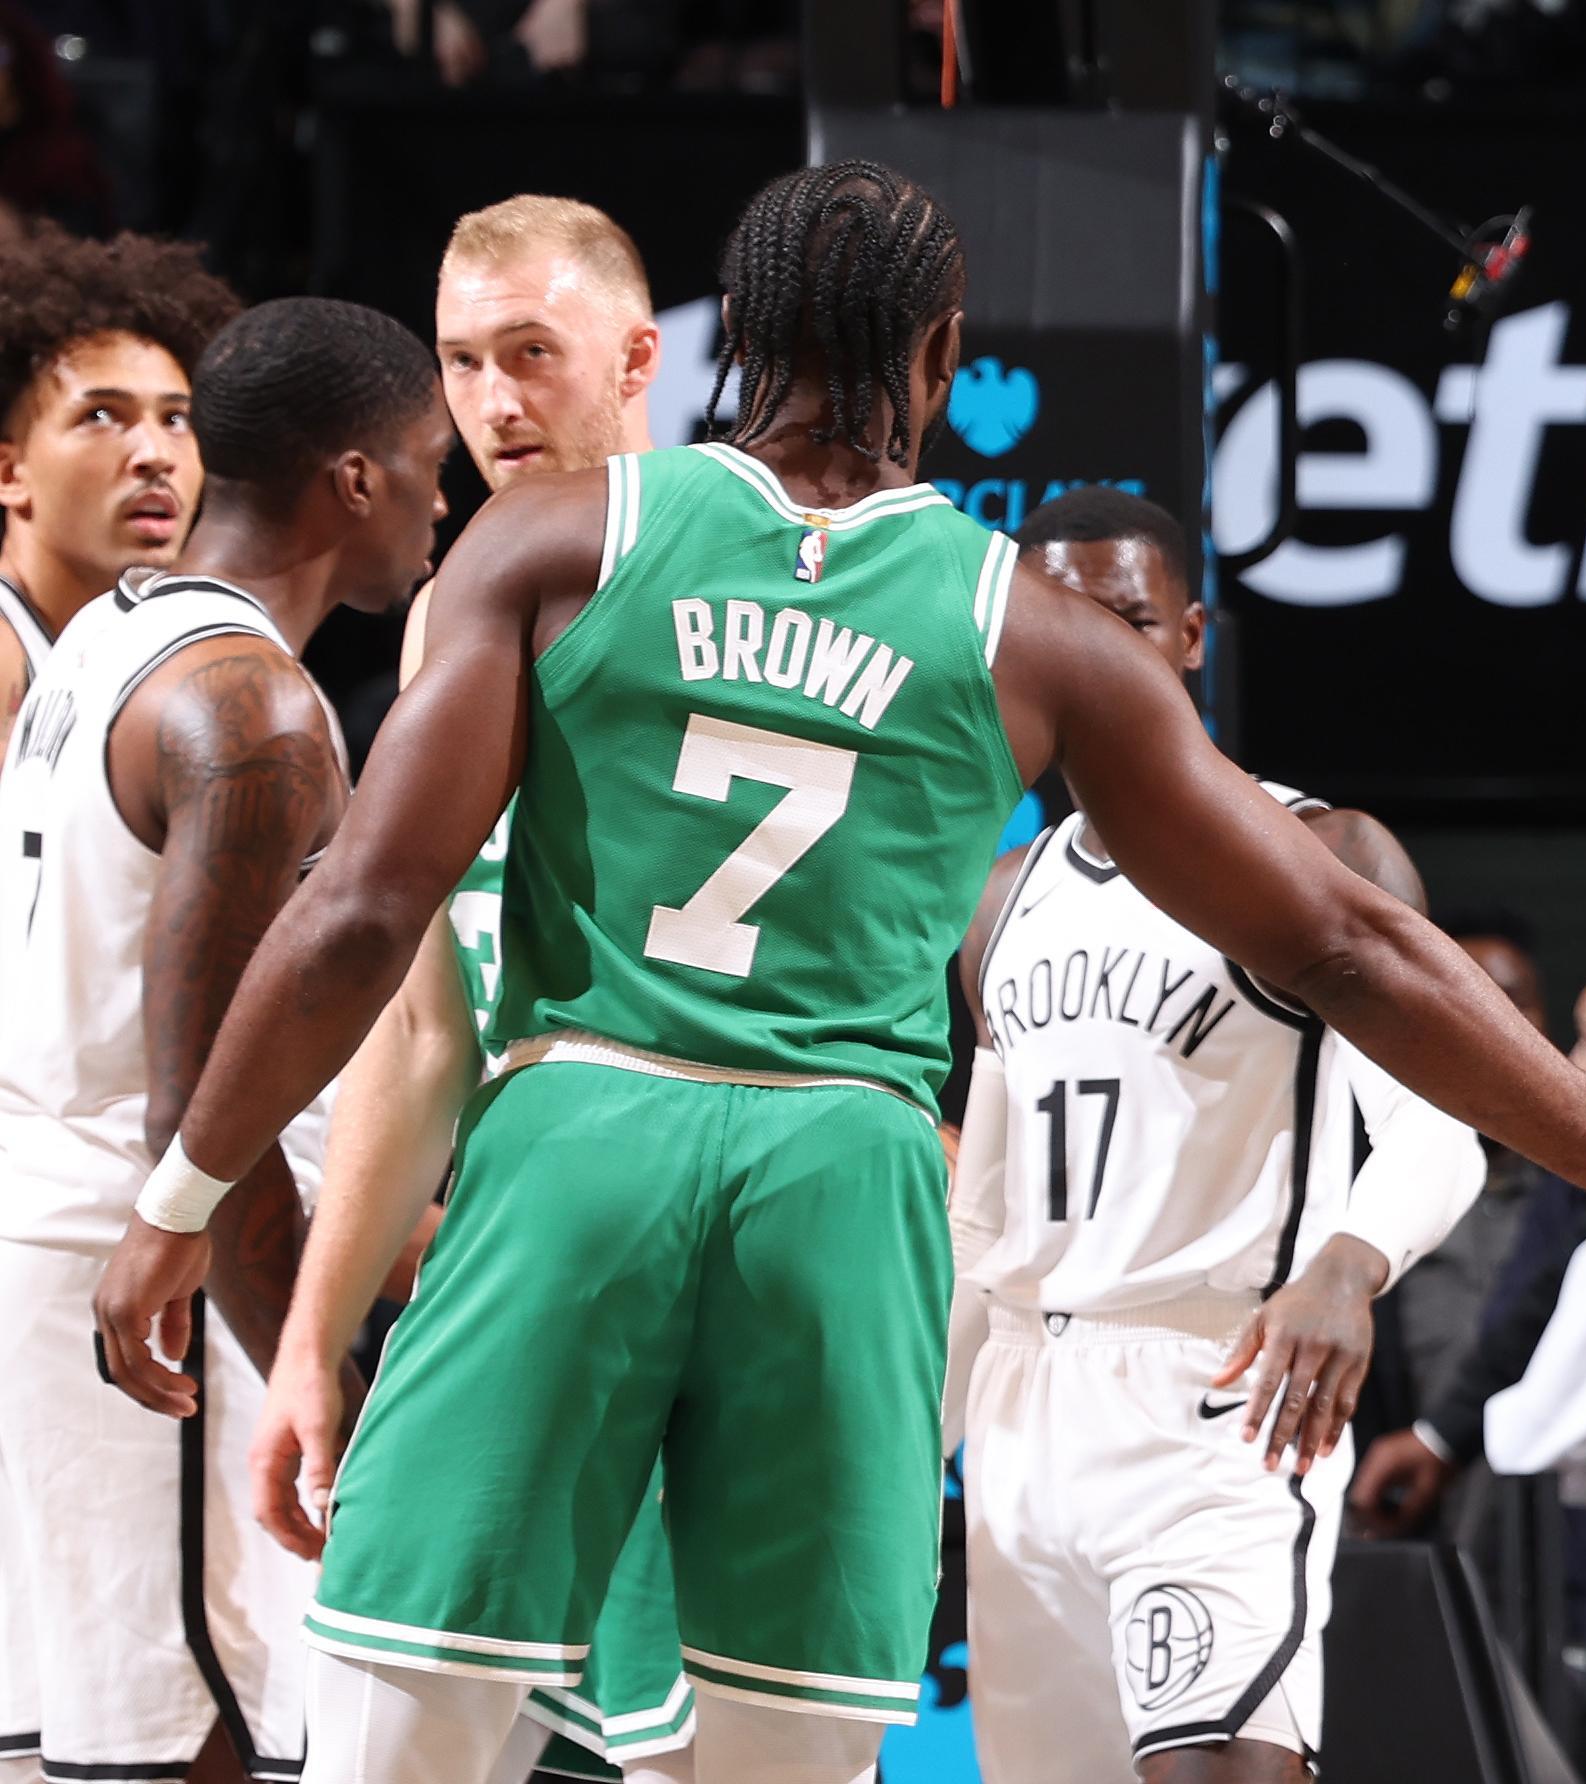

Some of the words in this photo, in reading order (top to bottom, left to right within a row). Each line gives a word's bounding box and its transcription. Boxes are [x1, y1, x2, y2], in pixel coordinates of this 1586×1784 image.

[672, 598, 914, 731] BROWN
[643, 712, 858, 978] 7
[1036, 1079, 1120, 1222] 17
[1147, 1606, 1172, 1690] B
